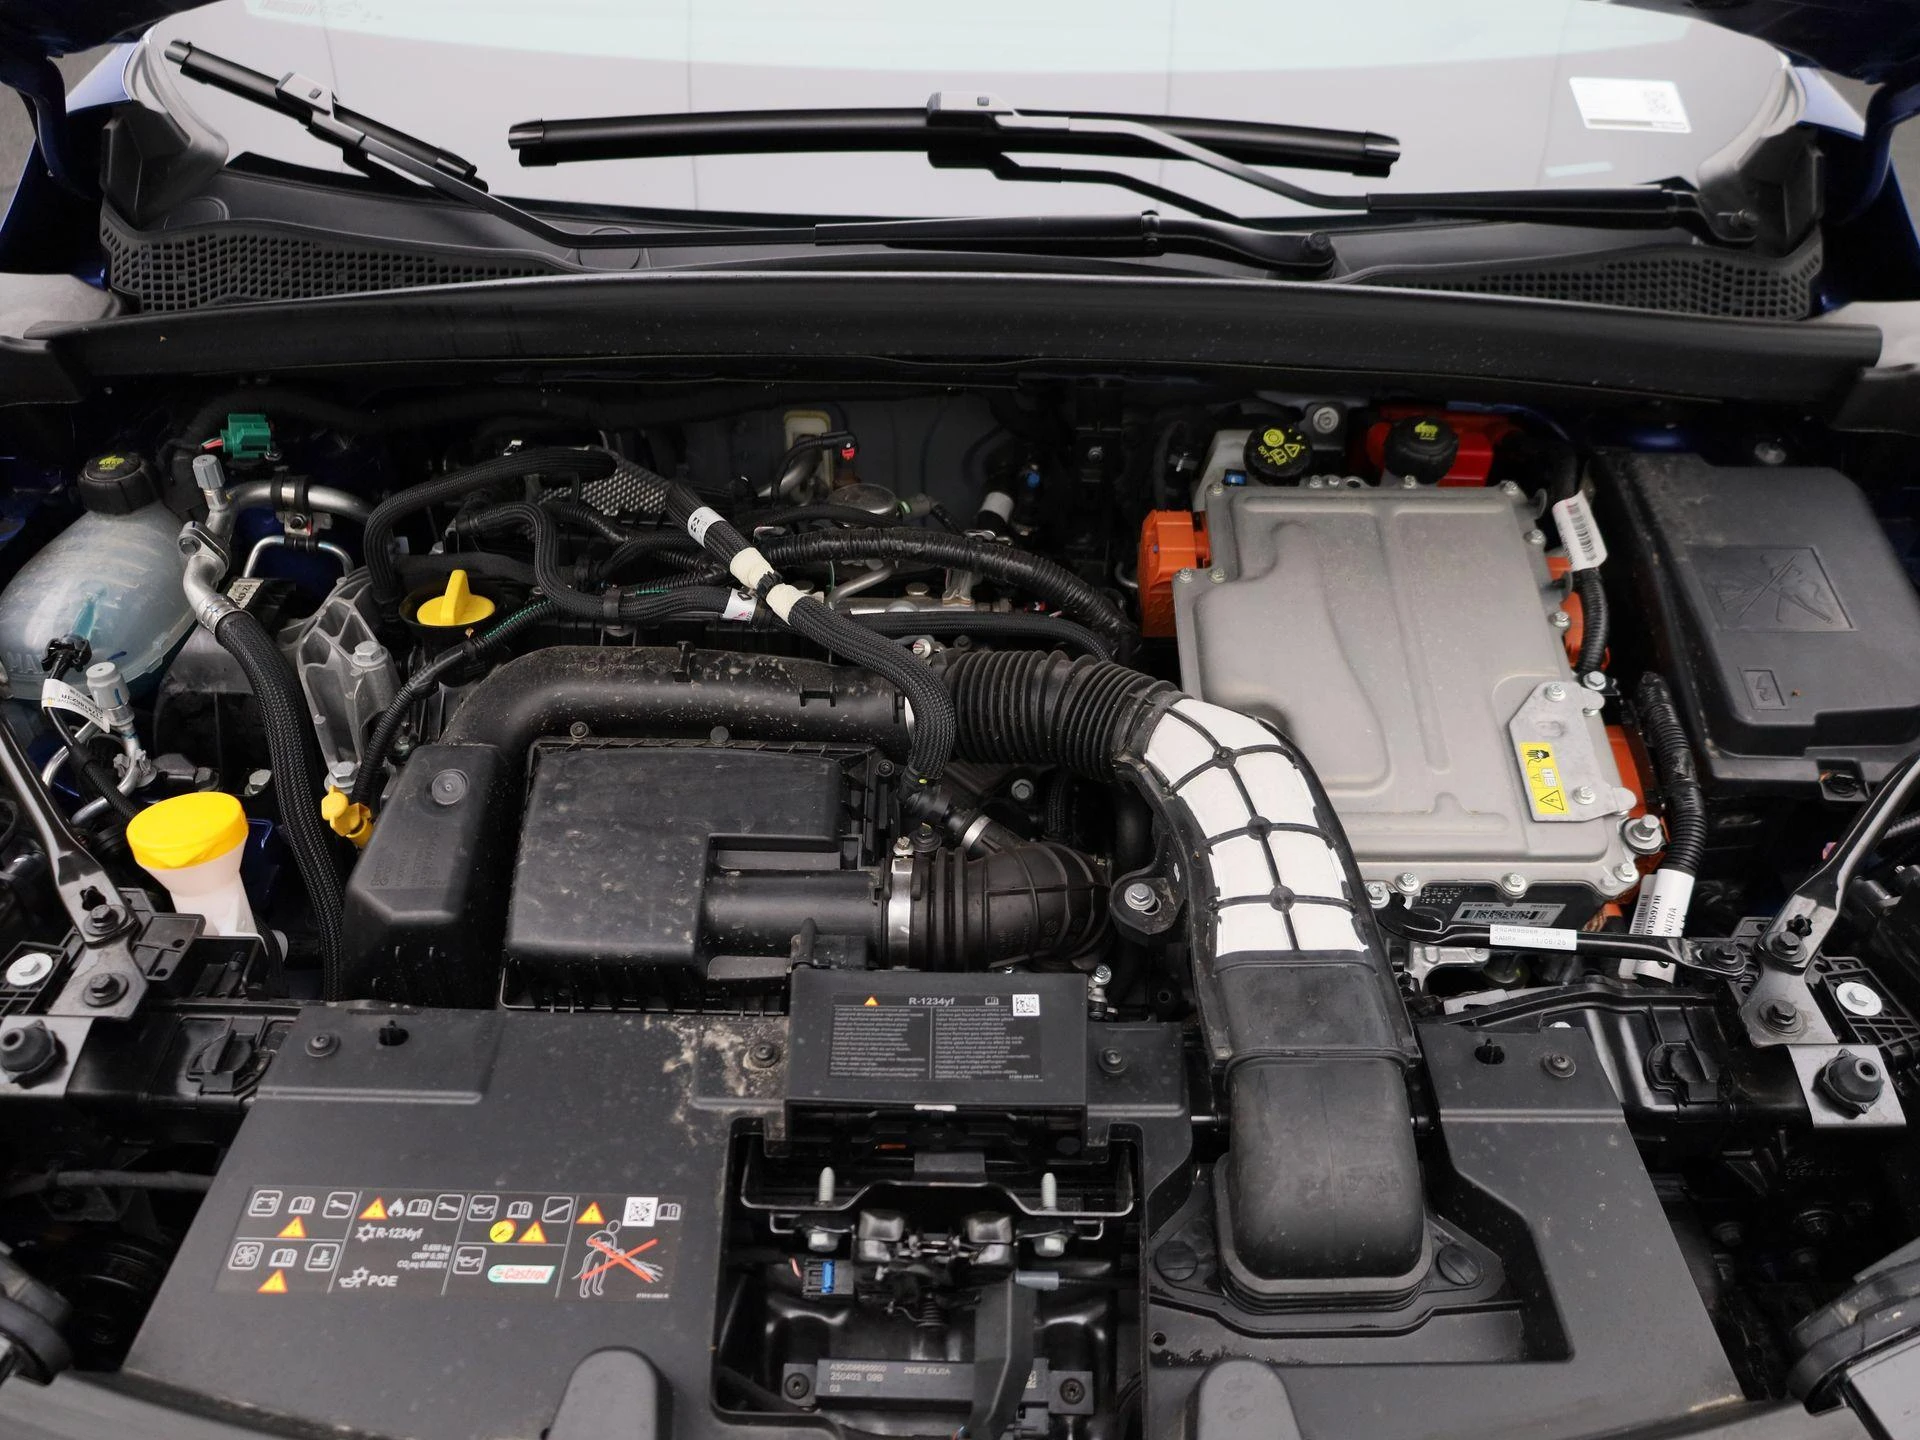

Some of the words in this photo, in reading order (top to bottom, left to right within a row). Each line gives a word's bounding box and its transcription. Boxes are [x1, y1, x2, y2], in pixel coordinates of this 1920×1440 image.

[908, 996, 955, 1007] R-1234yf
[375, 1227, 423, 1241] R-1234yf
[504, 1267, 549, 1280] Castrol
[367, 1274, 399, 1287] POE
